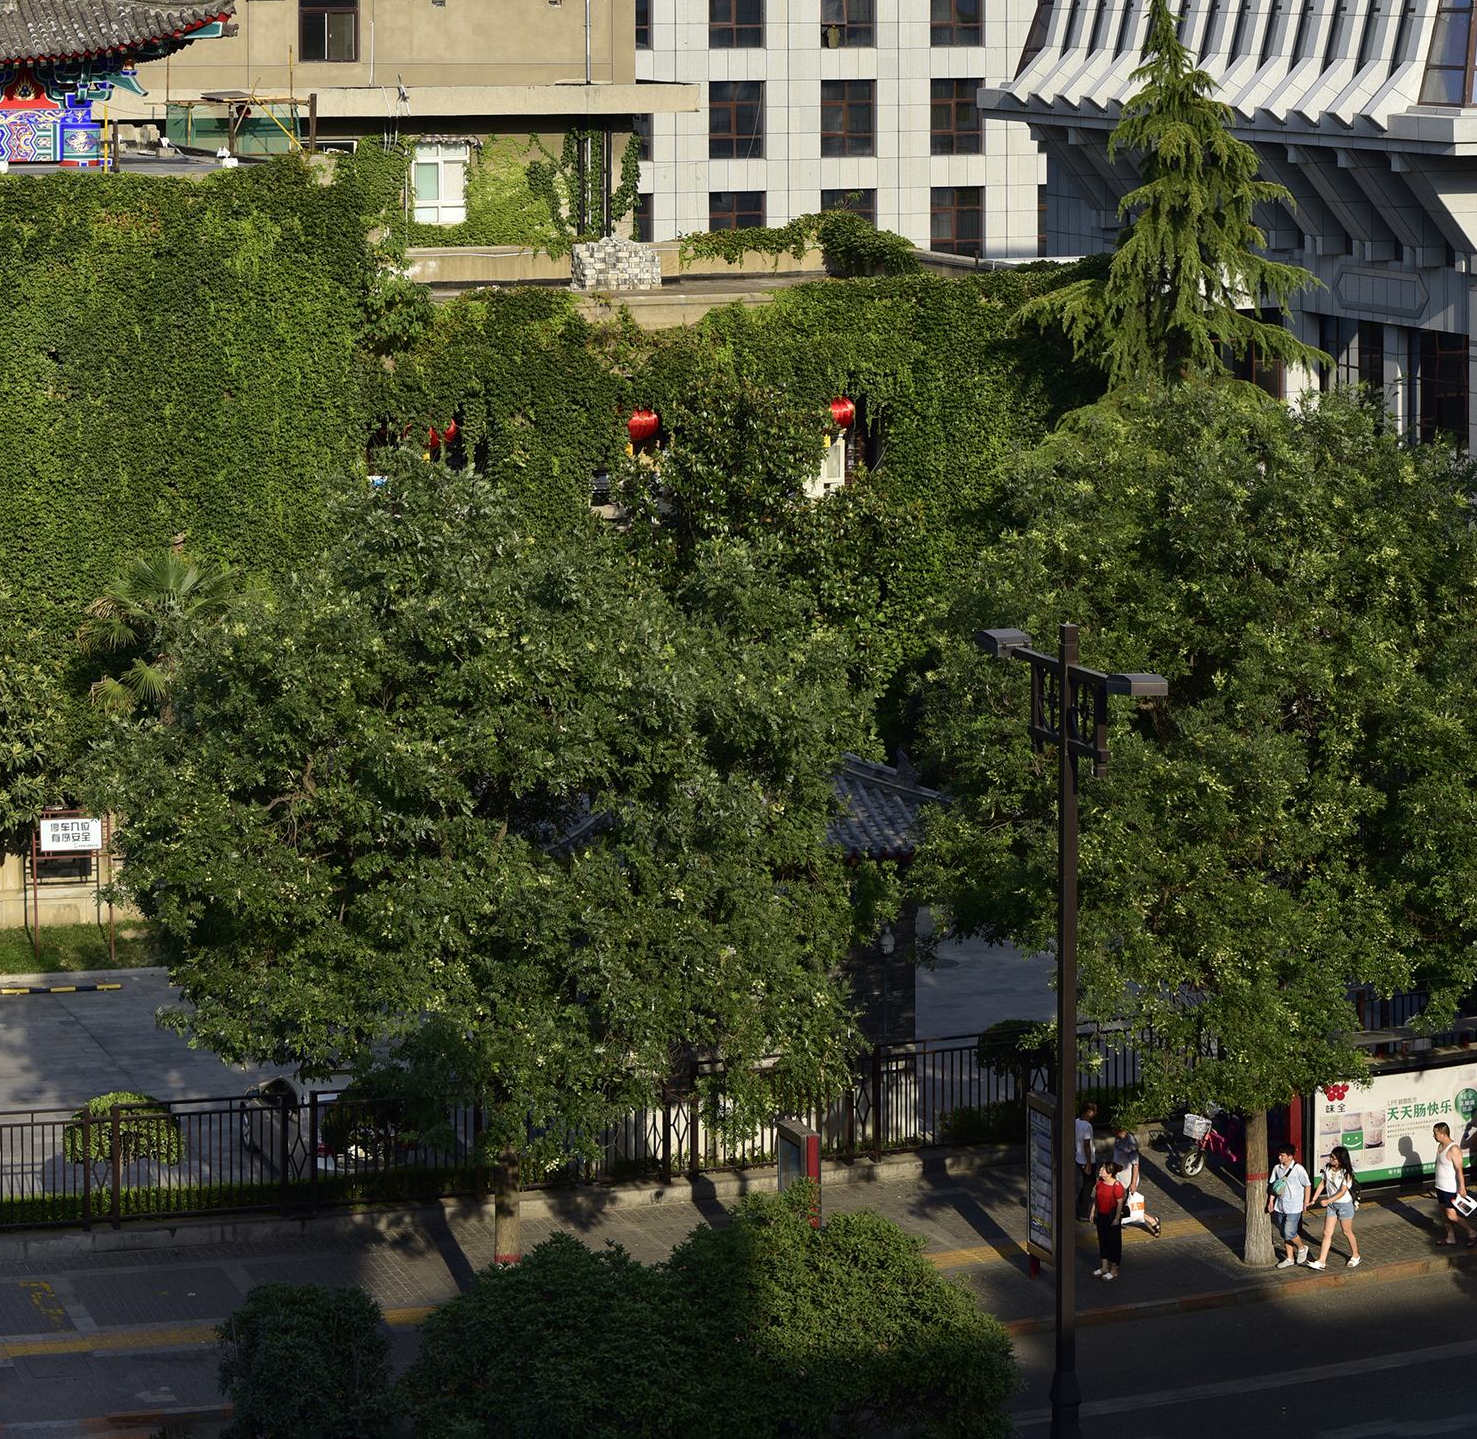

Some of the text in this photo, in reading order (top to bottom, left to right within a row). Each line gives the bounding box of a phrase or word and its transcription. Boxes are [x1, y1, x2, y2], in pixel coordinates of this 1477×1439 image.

[50, 821, 90, 832] 停车入位
[51, 832, 91, 843] 有序安全
[1325, 1103, 1347, 1114] 味全
[1387, 1099, 1452, 1122] 天天肠快乐
